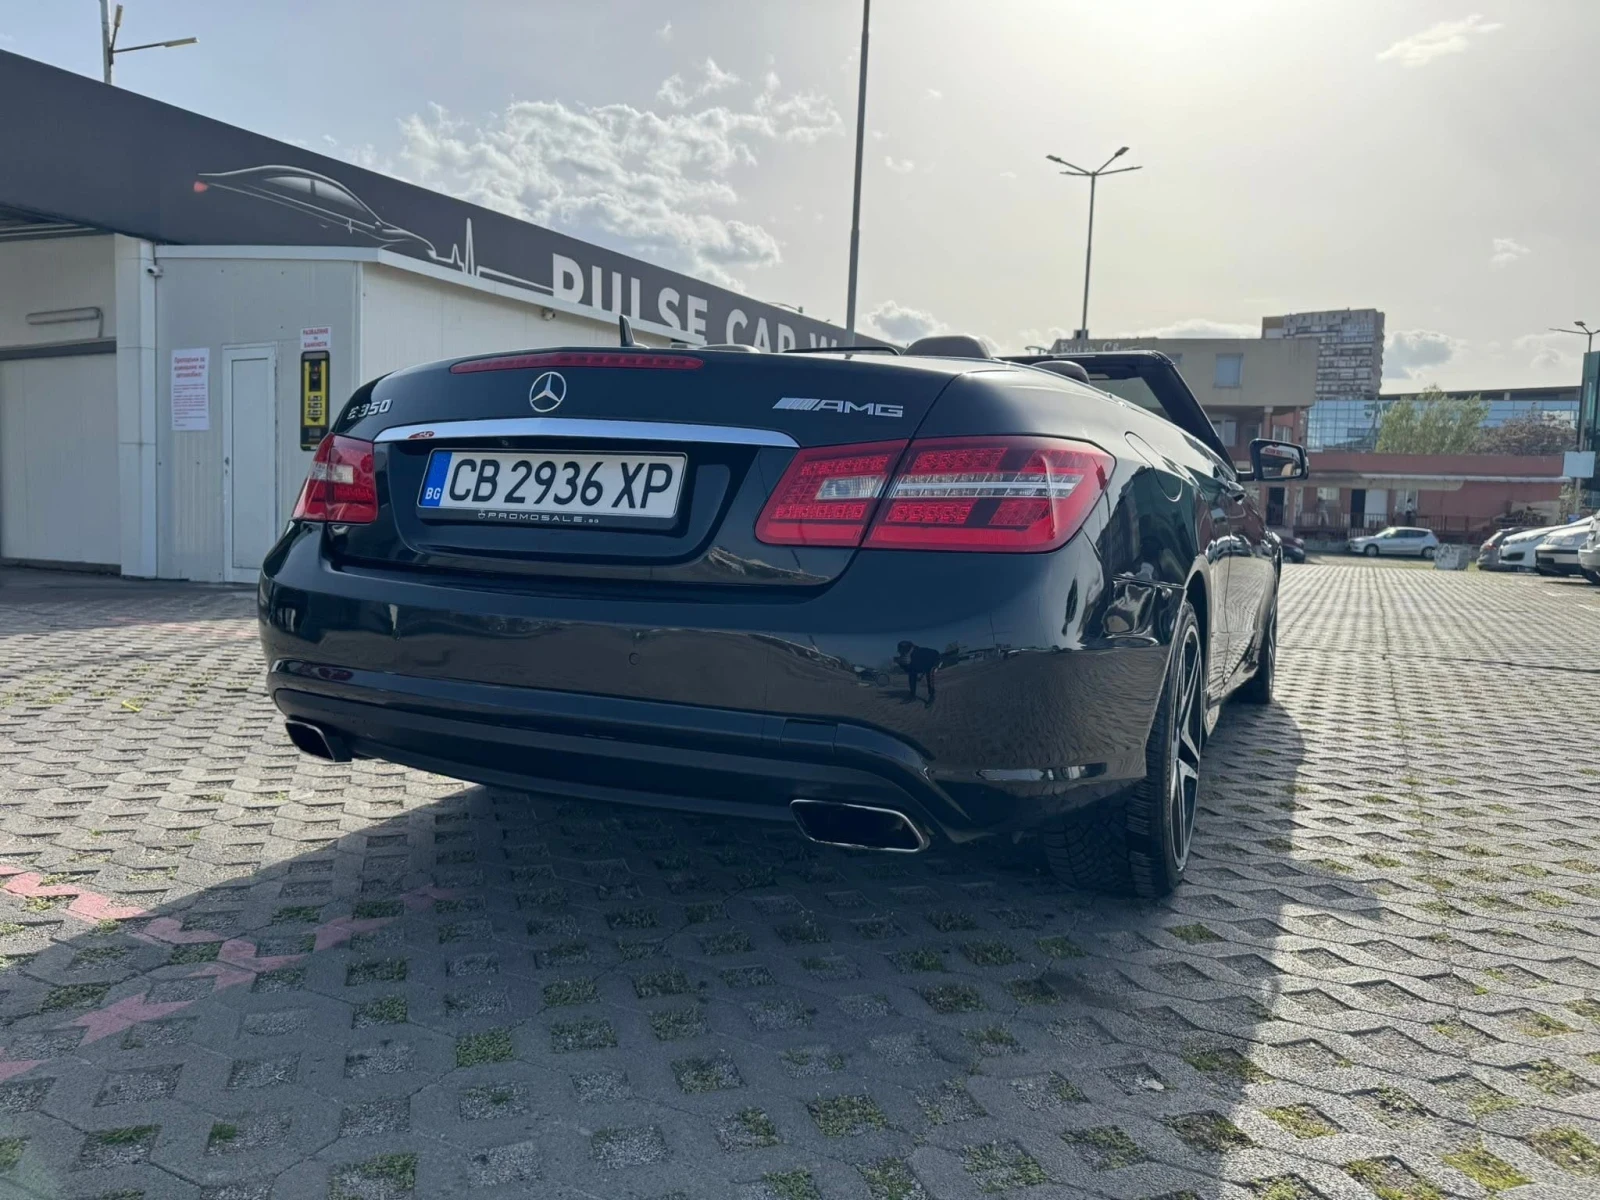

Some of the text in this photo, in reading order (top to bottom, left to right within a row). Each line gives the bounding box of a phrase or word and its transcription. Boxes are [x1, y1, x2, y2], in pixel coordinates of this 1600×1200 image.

[553, 253, 708, 342] PULSE
[358, 399, 392, 418] 350
[812, 399, 904, 418] AMG
[425, 487, 441, 500] BG
[450, 459, 673, 509] CB 2936 XP
